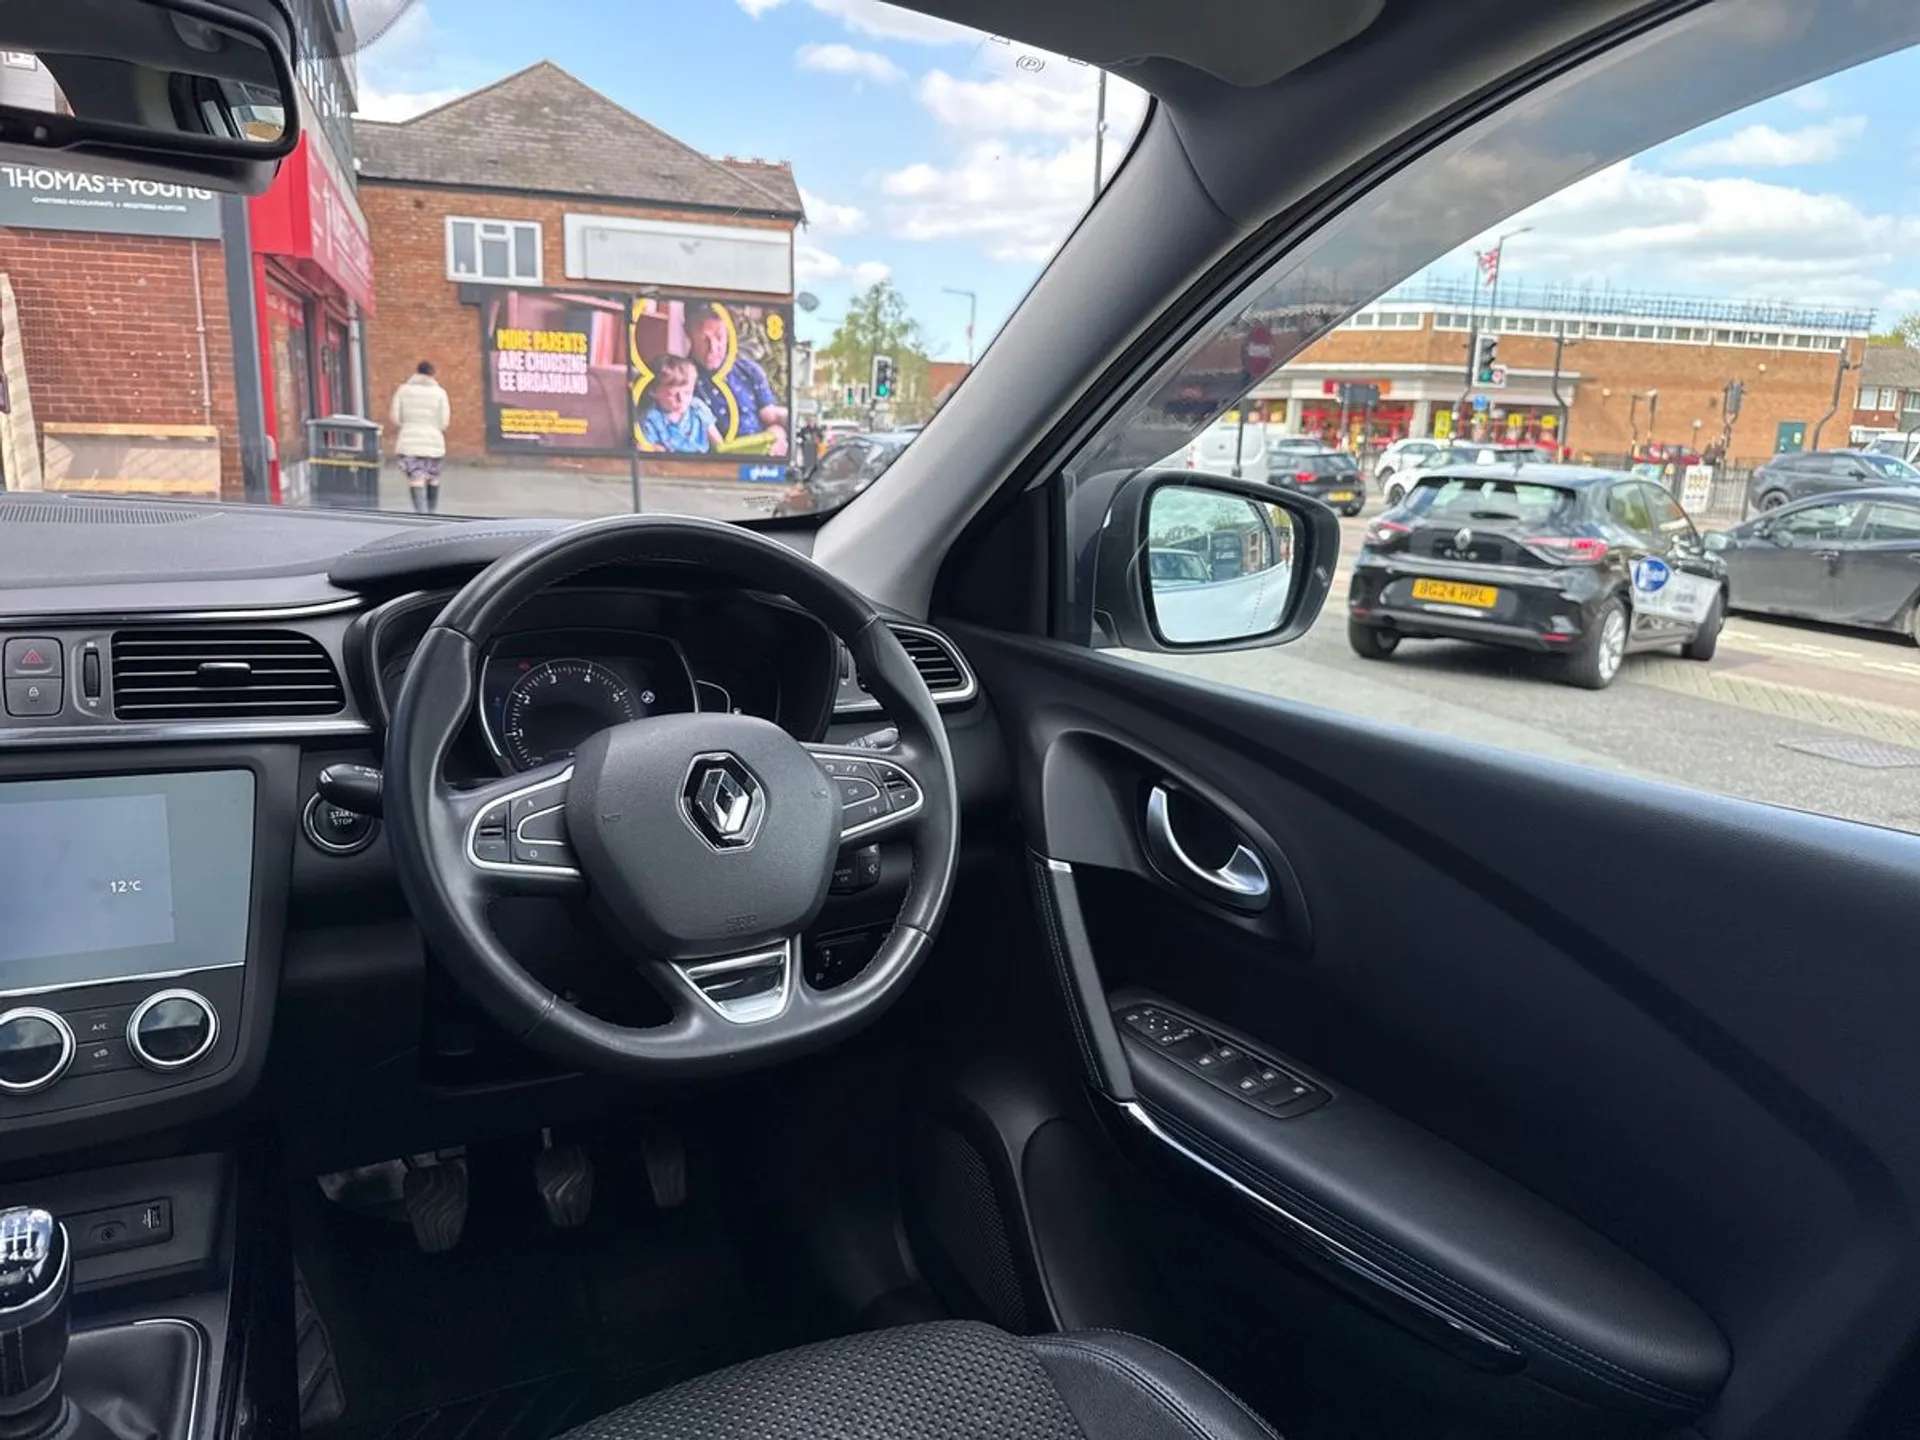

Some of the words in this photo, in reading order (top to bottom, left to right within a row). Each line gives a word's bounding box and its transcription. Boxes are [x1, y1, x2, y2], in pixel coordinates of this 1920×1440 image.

[497, 328, 532, 351] MORE
[532, 330, 587, 354] PARENTS
[498, 350, 525, 371] ARE
[525, 351, 587, 374] CHOOSING
[498, 371, 516, 392] EE
[516, 372, 588, 395] BROADBAND
